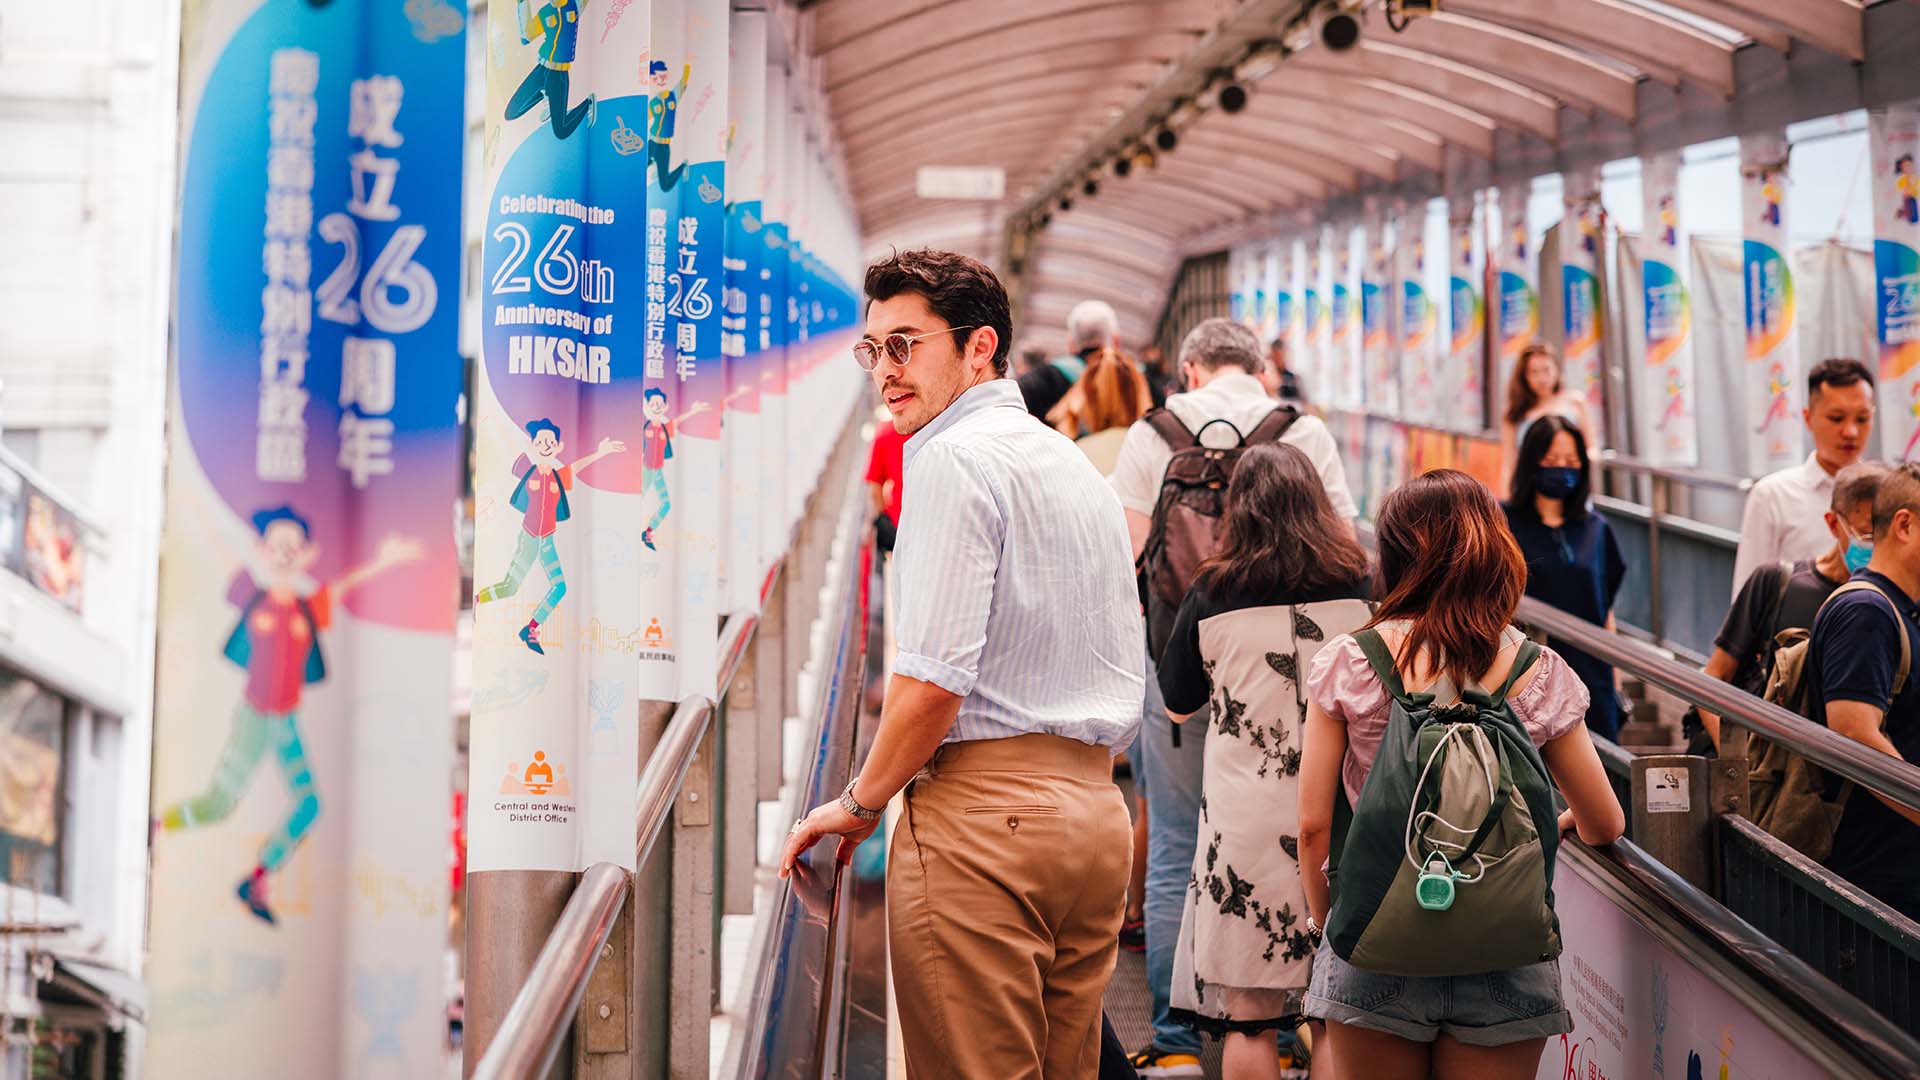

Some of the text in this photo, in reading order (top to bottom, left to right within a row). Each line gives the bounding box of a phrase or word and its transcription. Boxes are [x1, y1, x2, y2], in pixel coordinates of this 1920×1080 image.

[500, 194, 615, 225] Celebrating the
[491, 221, 615, 304] 26th
[495, 303, 613, 335] Anniversary of
[508, 335, 611, 384] HKSAR
[494, 802, 528, 811] Central
[510, 813, 568, 823] District Office
